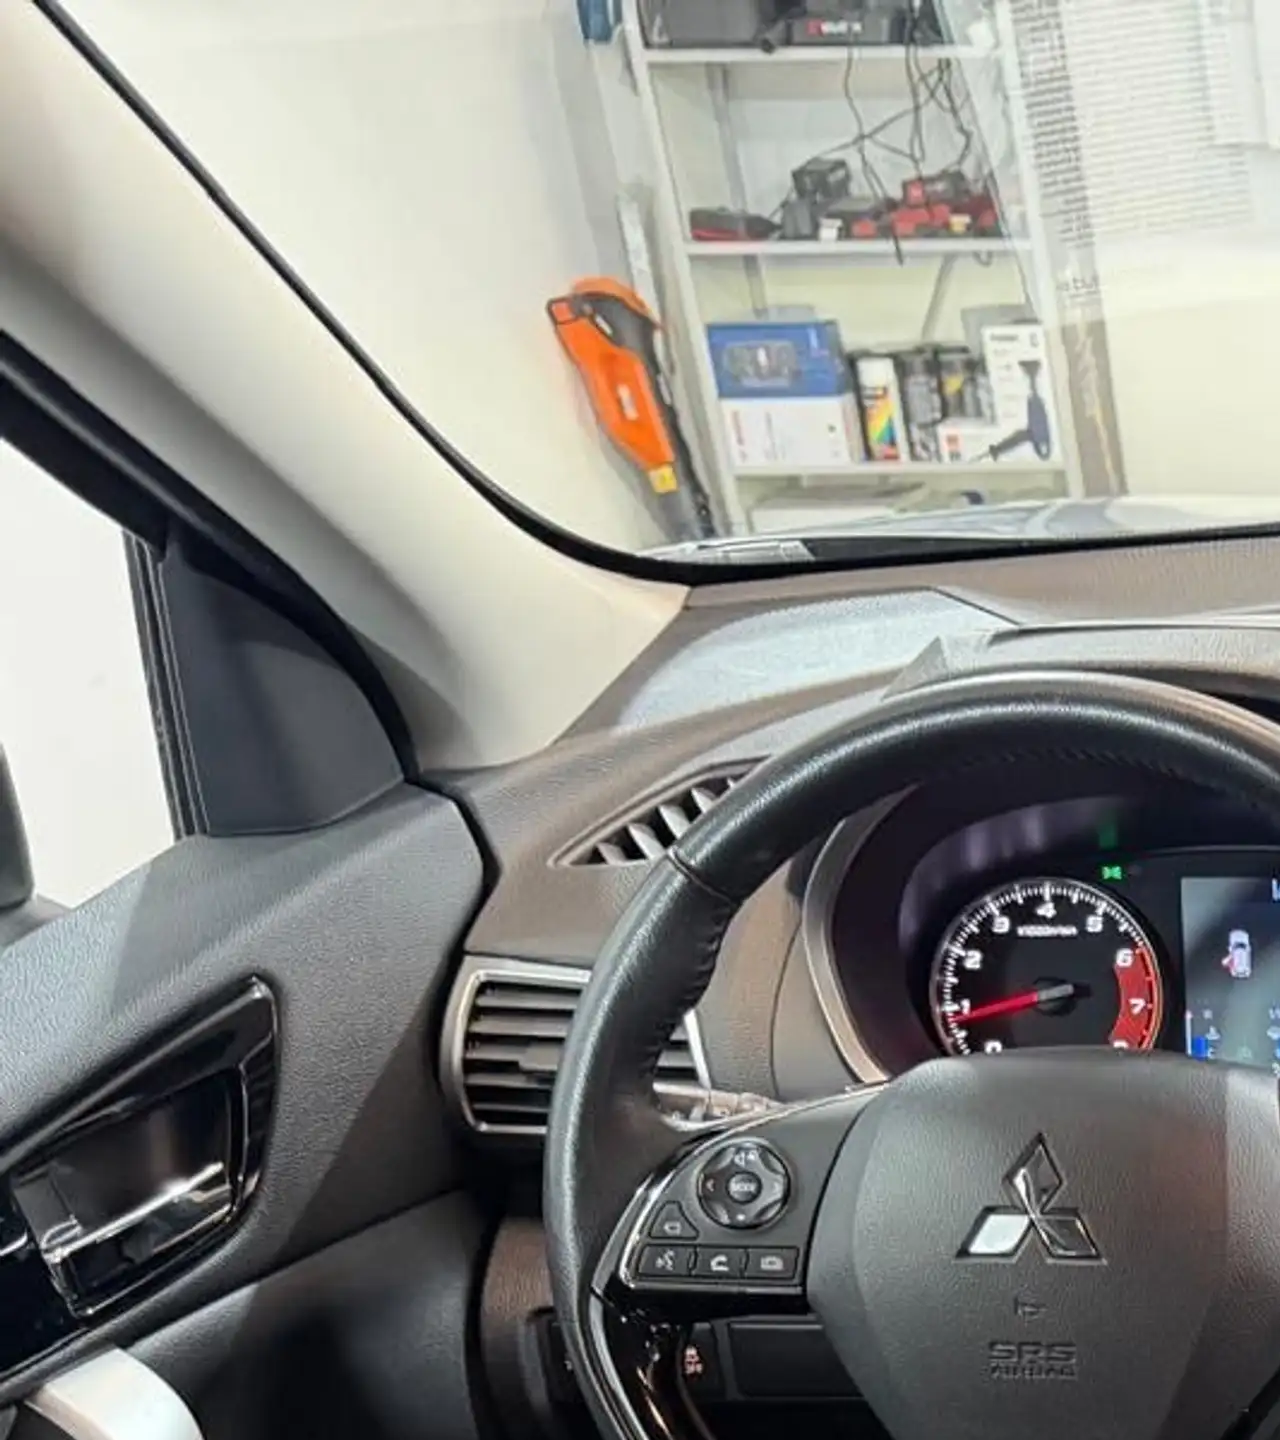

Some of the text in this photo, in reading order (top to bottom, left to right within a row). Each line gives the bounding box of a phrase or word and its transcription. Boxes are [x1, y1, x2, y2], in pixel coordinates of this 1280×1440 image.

[1035, 902, 1057, 918] 4
[992, 916, 1010, 934] 3
[1085, 915, 1103, 933] 5
[963, 950, 982, 969] 2
[1116, 949, 1134, 968] 6
[1129, 998, 1146, 1015] 7
[988, 1341, 1077, 1364] SRS
